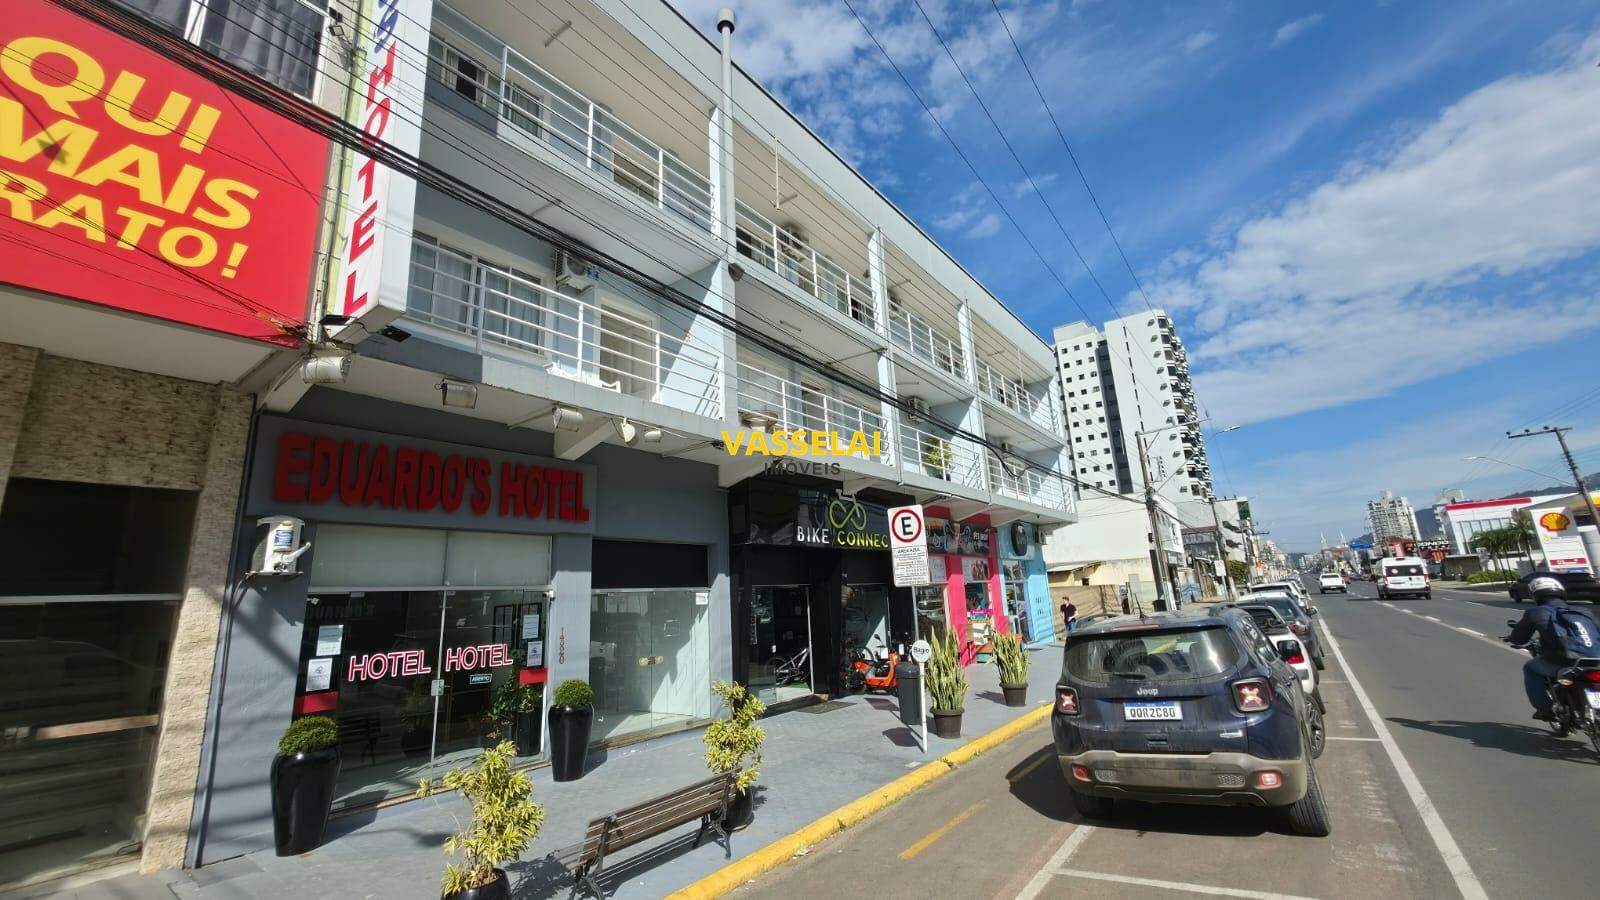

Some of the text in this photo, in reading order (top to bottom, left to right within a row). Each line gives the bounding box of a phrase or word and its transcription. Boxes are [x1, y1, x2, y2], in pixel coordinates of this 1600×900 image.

[0, 37, 222, 155] QUI
[0, 96, 259, 229] MAIS
[344, 41, 396, 315] HOTEL
[0, 170, 248, 279] RATO!
[273, 432, 590, 522] EDUARDO'S HOTEL
[796, 525, 830, 544] BIKE
[901, 516, 913, 536] E
[349, 650, 431, 682] HOTEL
[446, 644, 514, 672] HOTEL
[1136, 687, 1159, 696] Jeep
